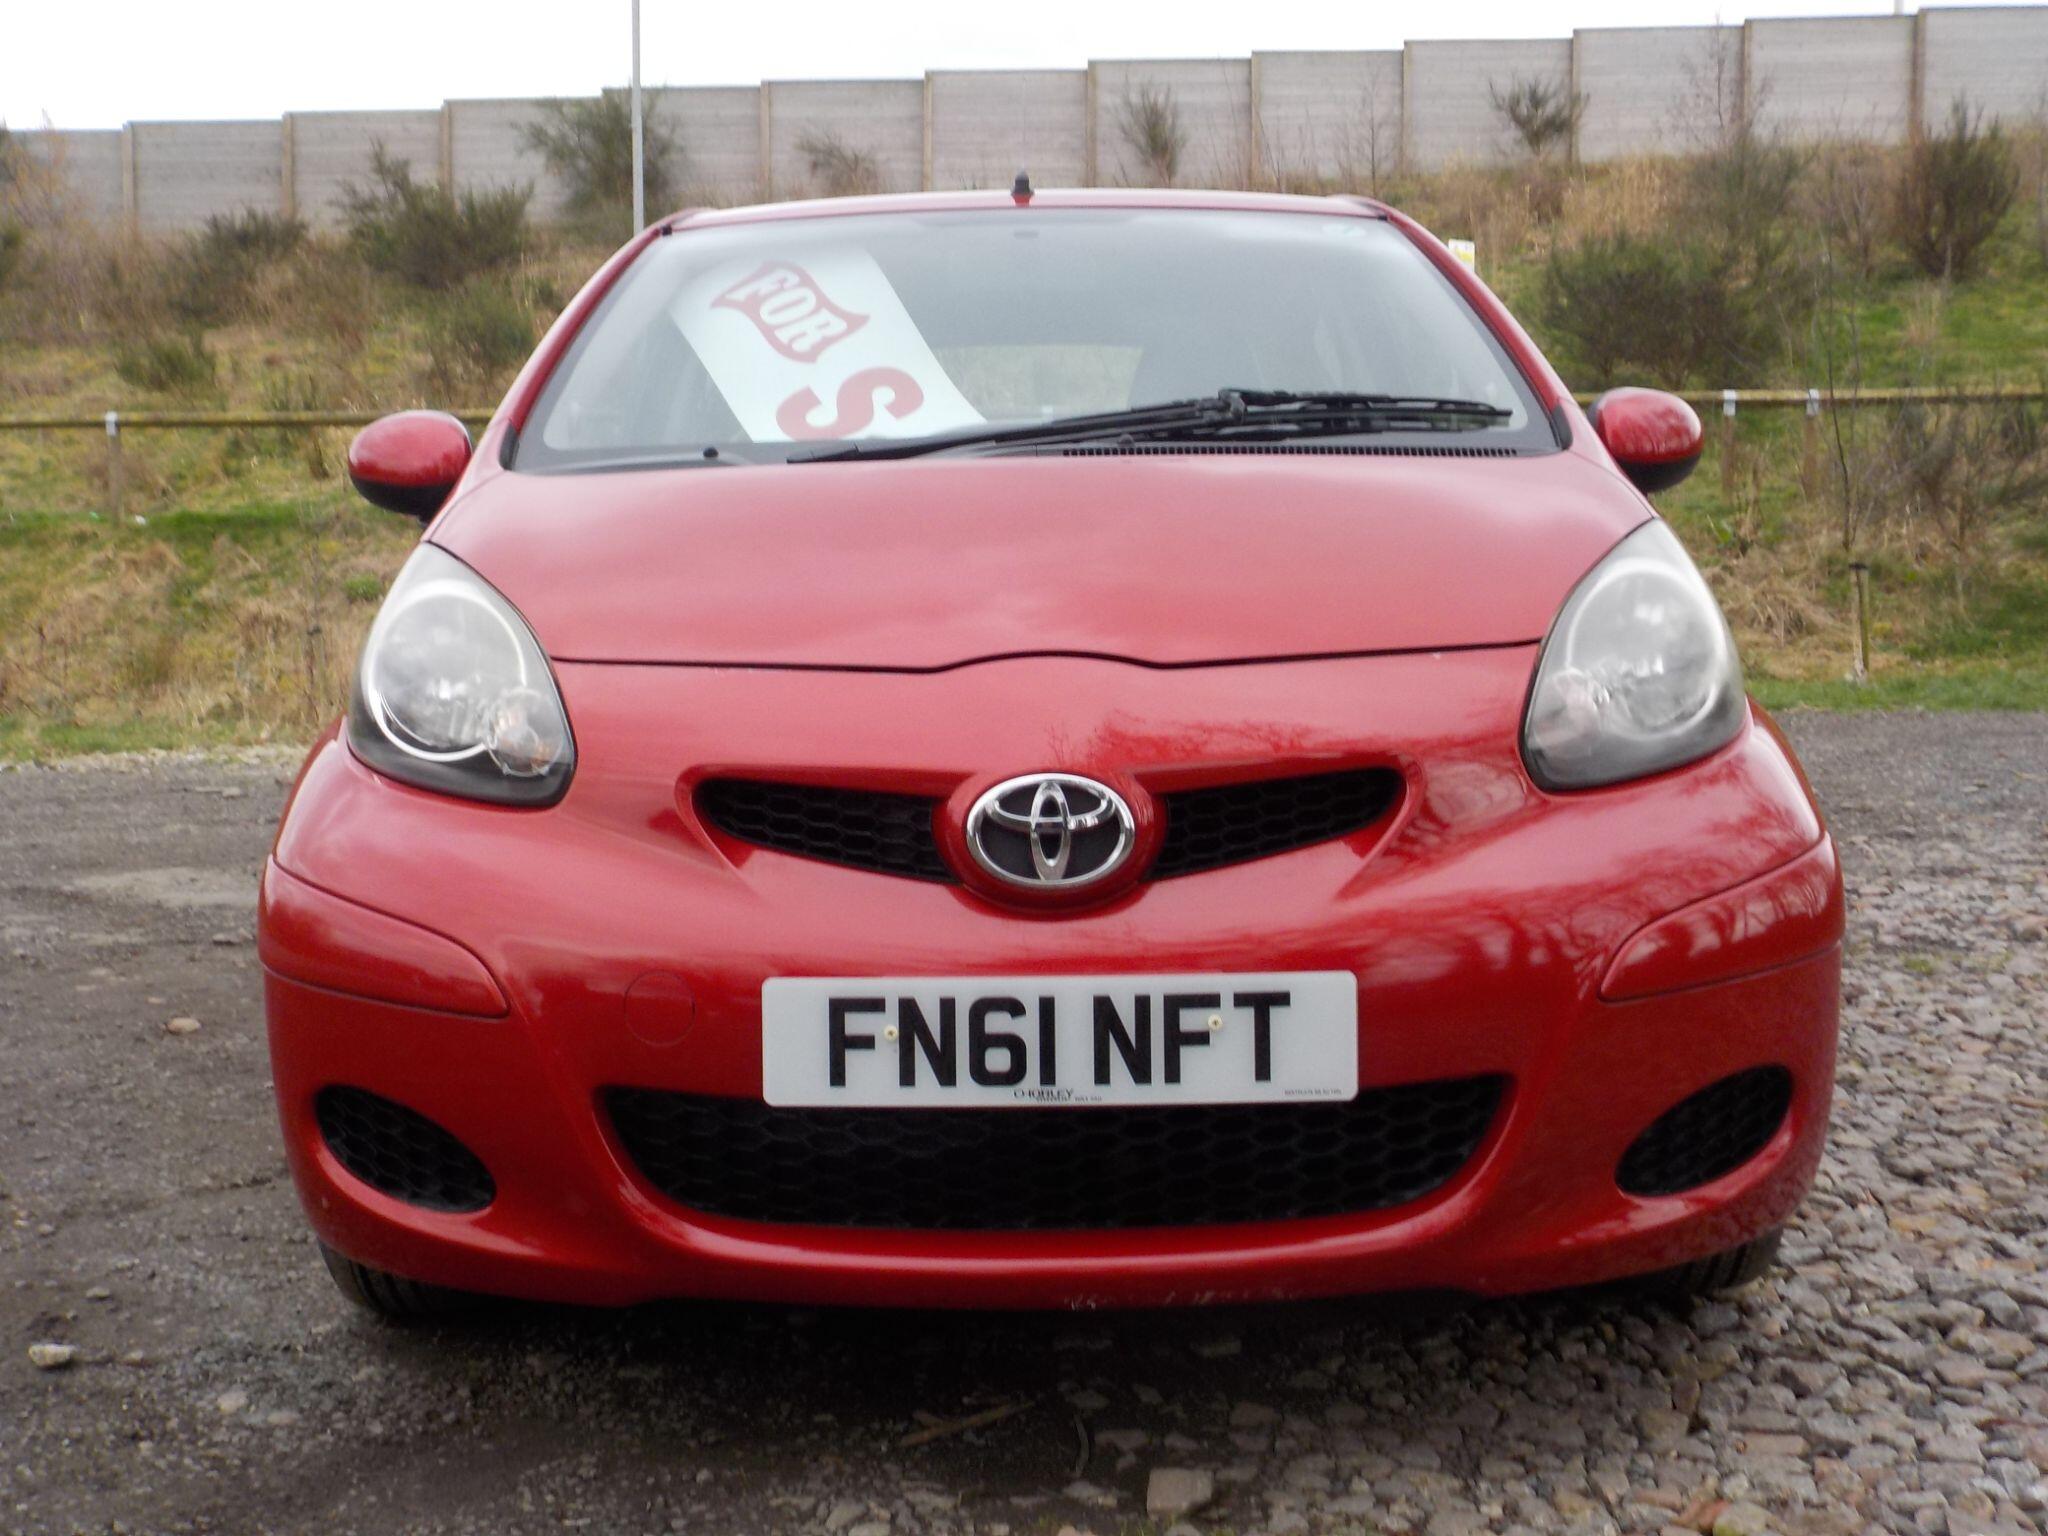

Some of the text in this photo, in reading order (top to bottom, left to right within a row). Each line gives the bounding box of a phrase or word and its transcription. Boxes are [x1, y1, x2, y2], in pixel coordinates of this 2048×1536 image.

[724, 266, 849, 354] FOR
[828, 991, 1291, 1087] FN61 NFT
